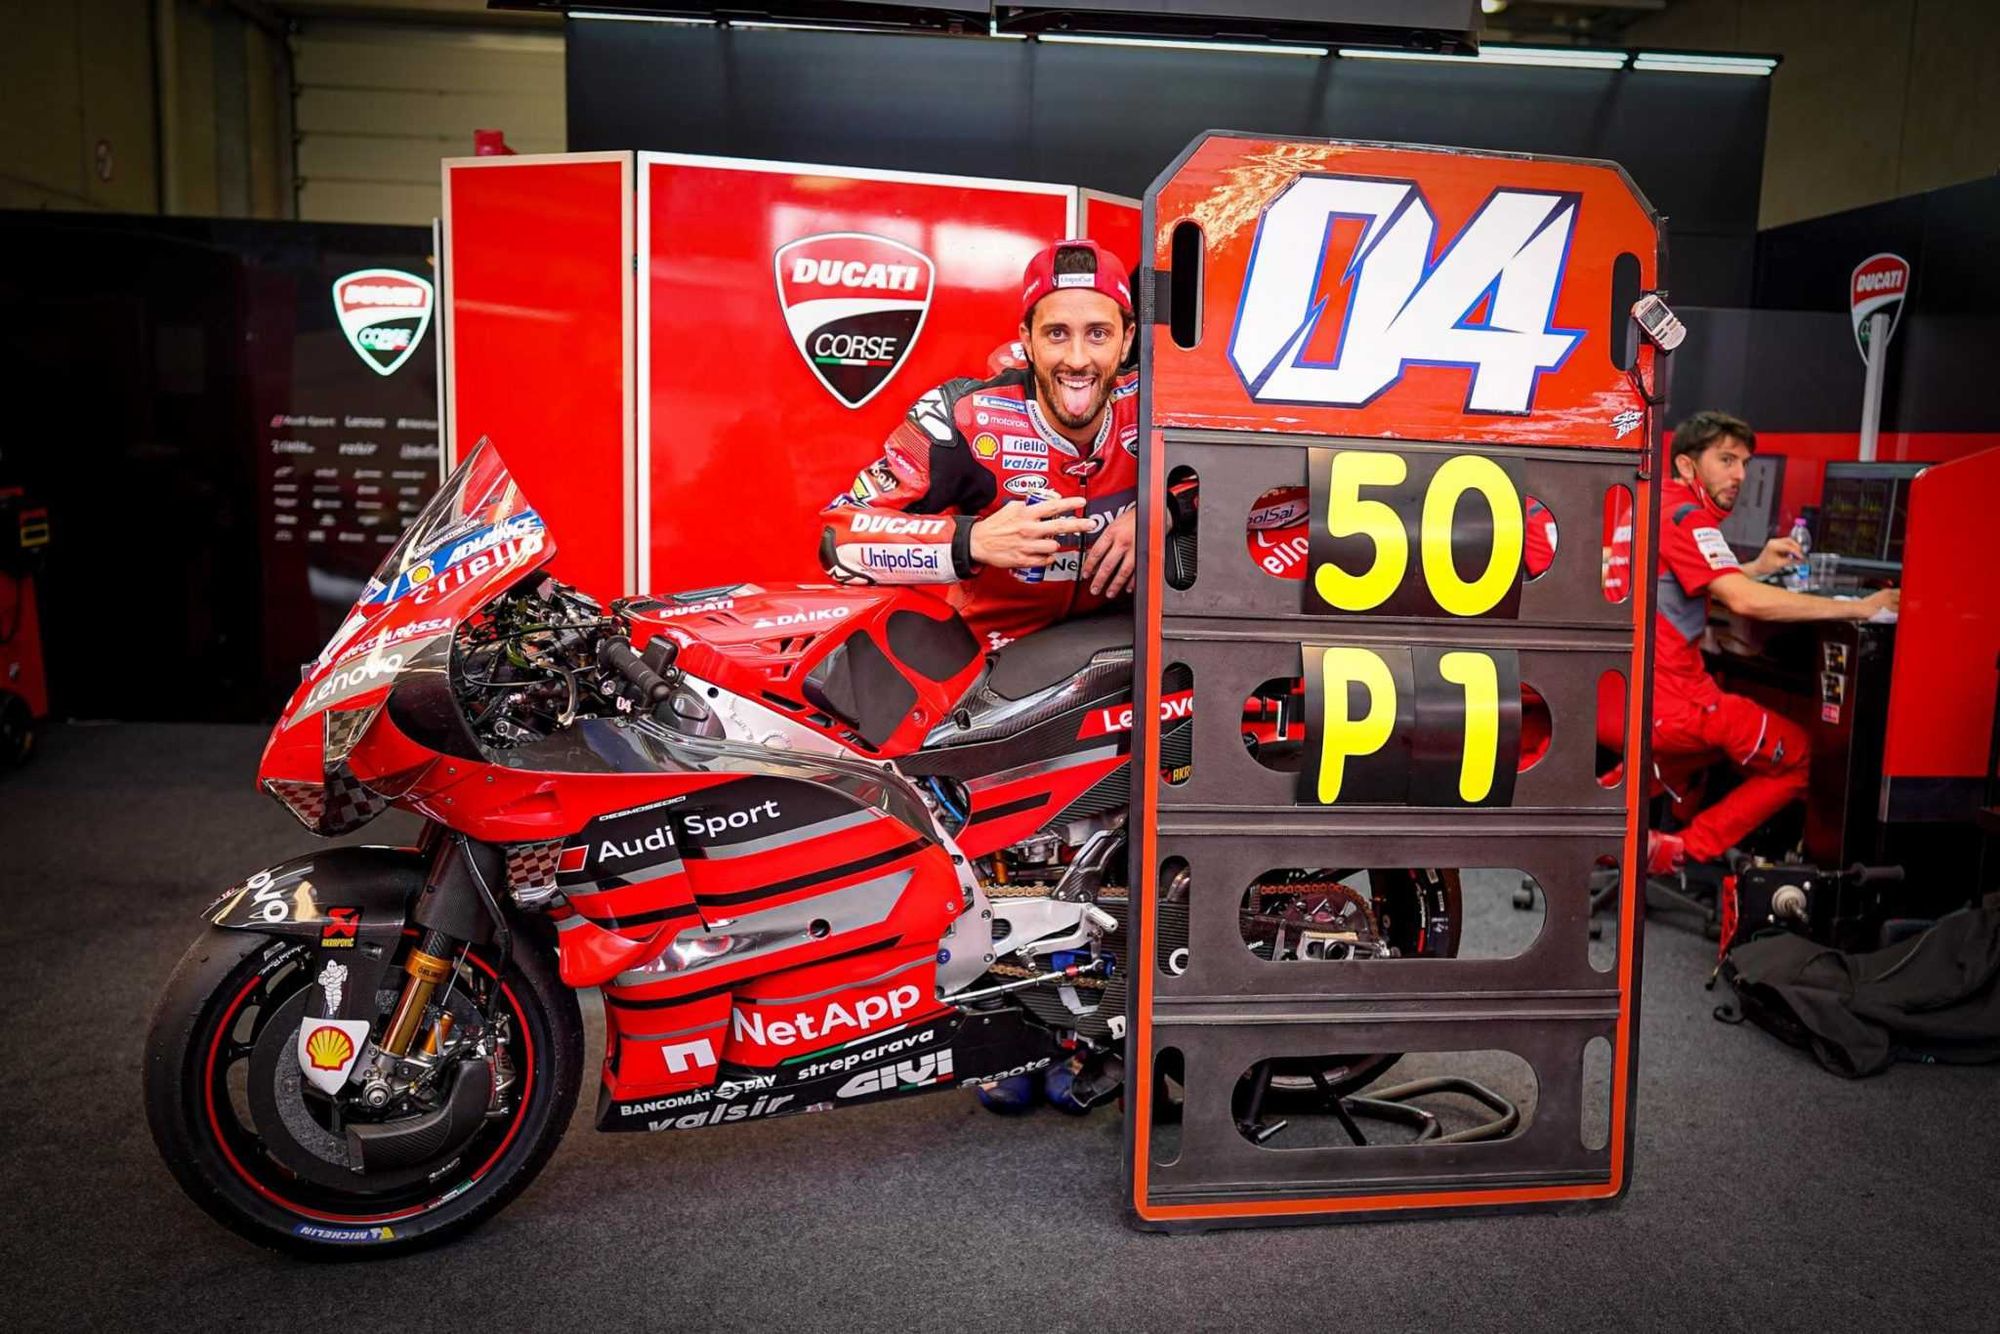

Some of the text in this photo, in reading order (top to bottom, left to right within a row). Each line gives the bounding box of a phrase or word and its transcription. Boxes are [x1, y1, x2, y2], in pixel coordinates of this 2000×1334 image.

[792, 258, 919, 291] DUCATI
[1857, 270, 1903, 292] DUCATI
[1227, 172, 1588, 417] 04
[815, 333, 897, 360] CORSE
[990, 416, 1030, 429] motorola
[1014, 440, 1046, 453] riello
[1004, 457, 1047, 470] valsir
[850, 514, 946, 534] DUCATI
[1248, 504, 1295, 525] olSai
[1315, 451, 1524, 617] 50
[861, 547, 938, 572] UnipolSai
[1263, 537, 1309, 573] ello
[660, 599, 733, 618] DUCATI
[777, 606, 849, 626] DAIKO
[304, 653, 402, 711] Lenovo
[599, 795, 686, 822] DESMOSEDICI
[598, 799, 781, 863] Audi Sport
[732, 984, 920, 1047] NetApp
[798, 1029, 934, 1081] streparava
[836, 1048, 953, 1098] GIVI
[620, 1075, 777, 1116] BANCOMAT PAY
[648, 1094, 795, 1133] valsir
[300, 1226, 369, 1240] MICHELIN
